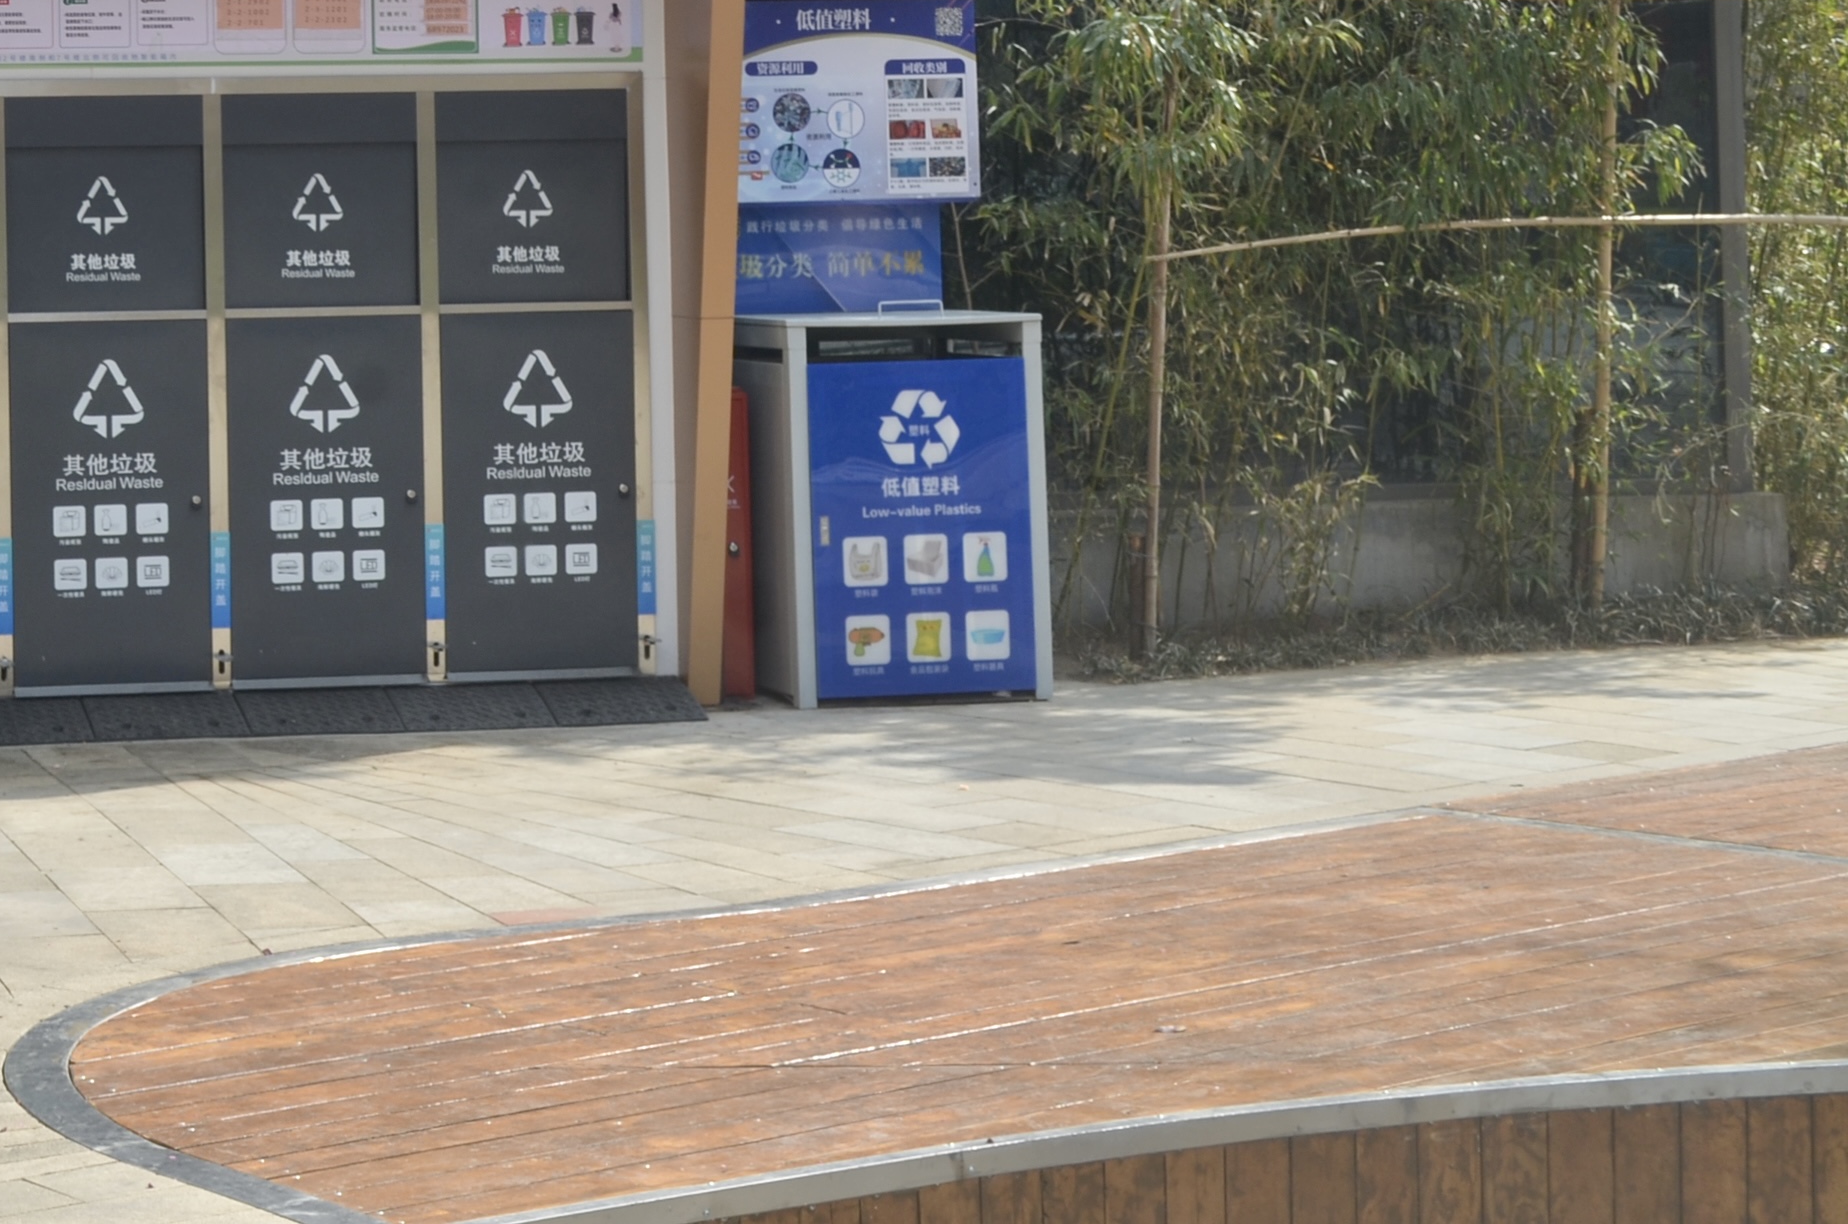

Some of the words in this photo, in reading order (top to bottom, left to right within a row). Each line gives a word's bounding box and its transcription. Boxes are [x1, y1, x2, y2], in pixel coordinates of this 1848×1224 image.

[796, 8, 871, 31] 低值塑料
[757, 62, 805, 75] 资源利用
[902, 61, 947, 74] 回收类别
[286, 250, 350, 266] 其他垃圾
[497, 245, 560, 262] 其他垃圾
[71, 253, 136, 270] 其他垃圾
[492, 263, 534, 274] Residual
[537, 262, 565, 273] Waste
[740, 253, 813, 279] 圾分类
[827, 250, 924, 278] 简单不累
[66, 271, 108, 282] Residual
[111, 270, 141, 281] Waste
[281, 267, 323, 278] Residual
[325, 267, 355, 277] Waste
[908, 424, 930, 437] 塑料
[280, 447, 373, 471] 其他垃圾
[493, 442, 585, 466] 其他垃圾
[63, 453, 157, 477] 其他垃圾
[487, 466, 546, 479] Residual
[548, 465, 591, 478] Waste
[56, 478, 116, 491] Residual
[119, 477, 164, 489] Waste
[273, 472, 333, 485] Residual
[336, 471, 379, 483] Waste
[881, 475, 960, 498] 低值塑料
[862, 505, 931, 518] Low-value
[934, 503, 981, 516] Plastics
